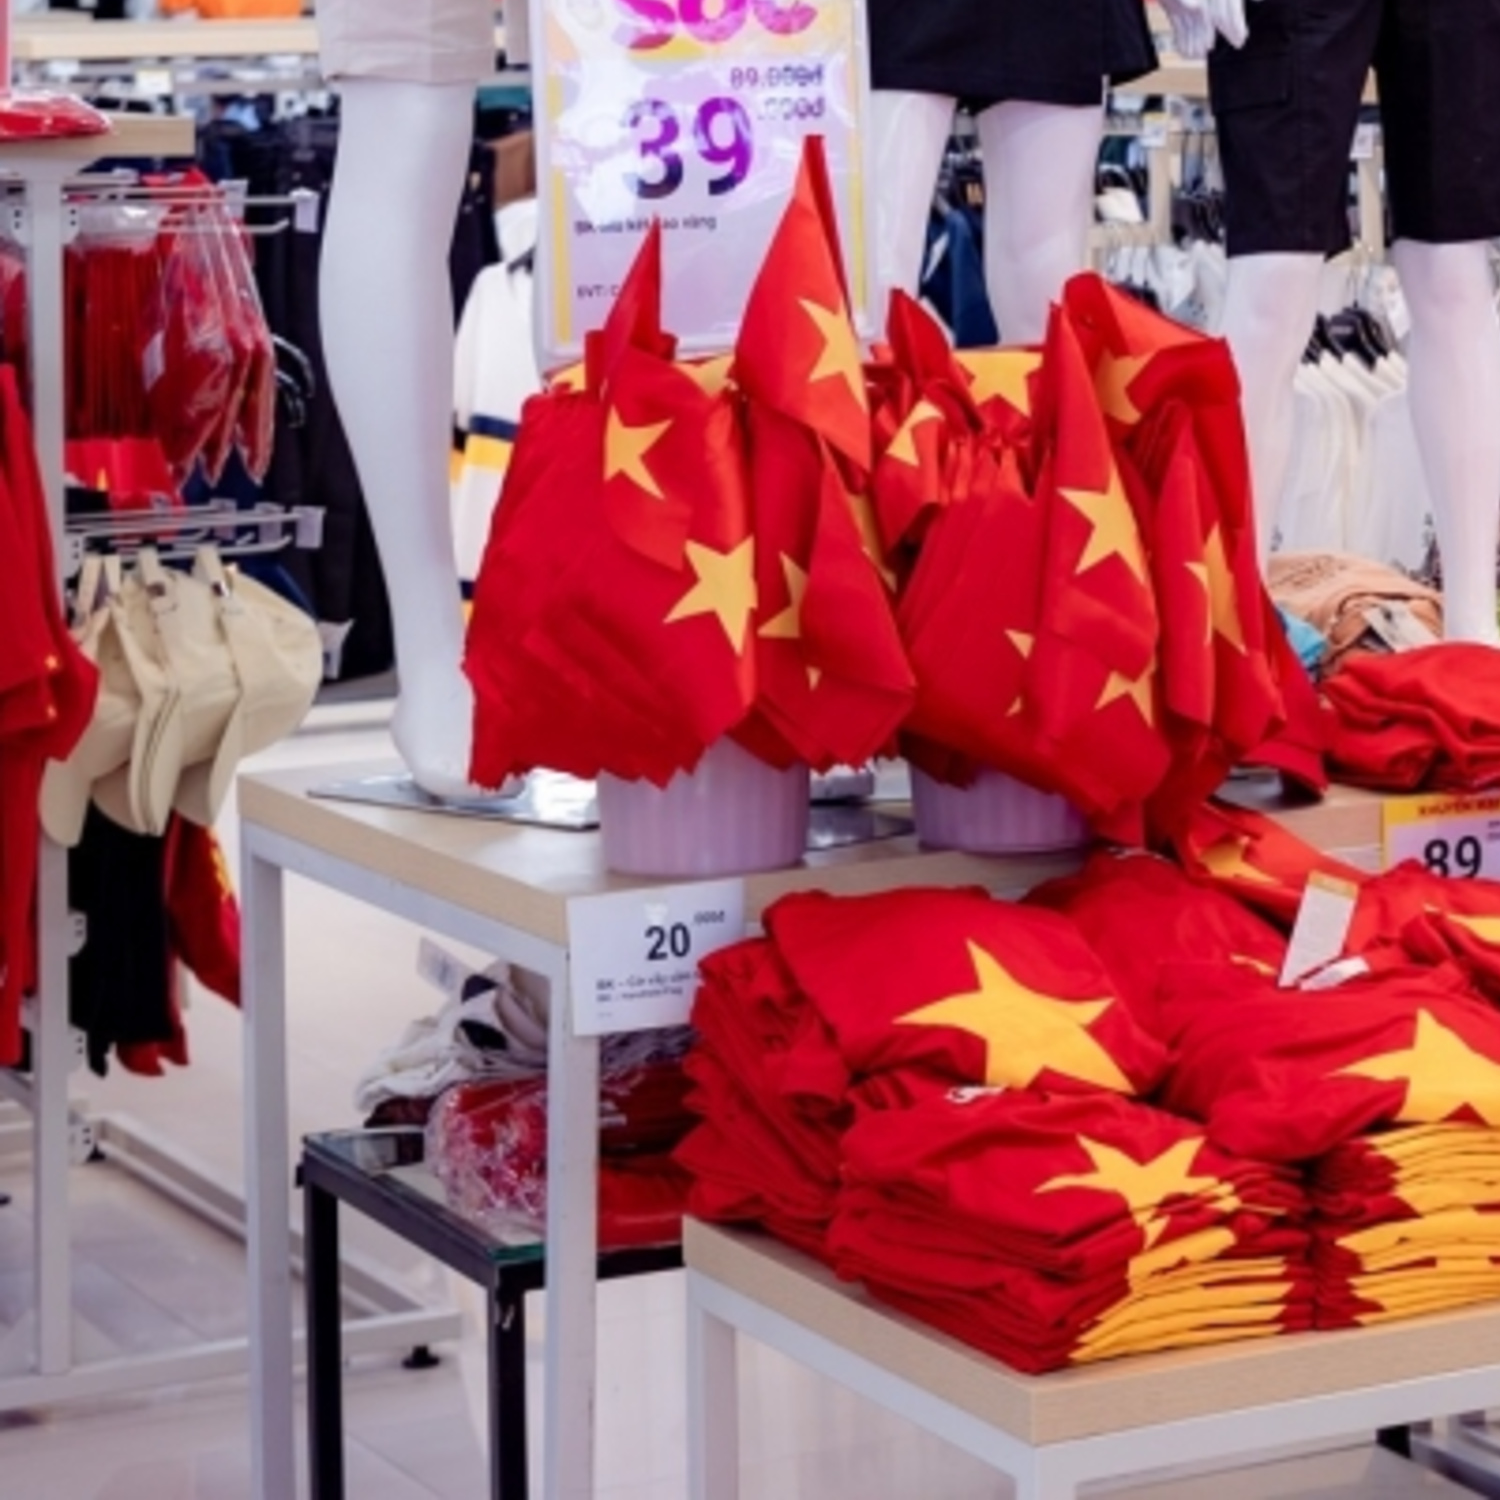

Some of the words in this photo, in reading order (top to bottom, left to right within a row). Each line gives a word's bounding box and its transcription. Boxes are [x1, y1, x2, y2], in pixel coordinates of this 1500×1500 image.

[621, 96, 754, 199] 39
[1424, 835, 1482, 879] 89
[645, 921, 691, 961] 20
